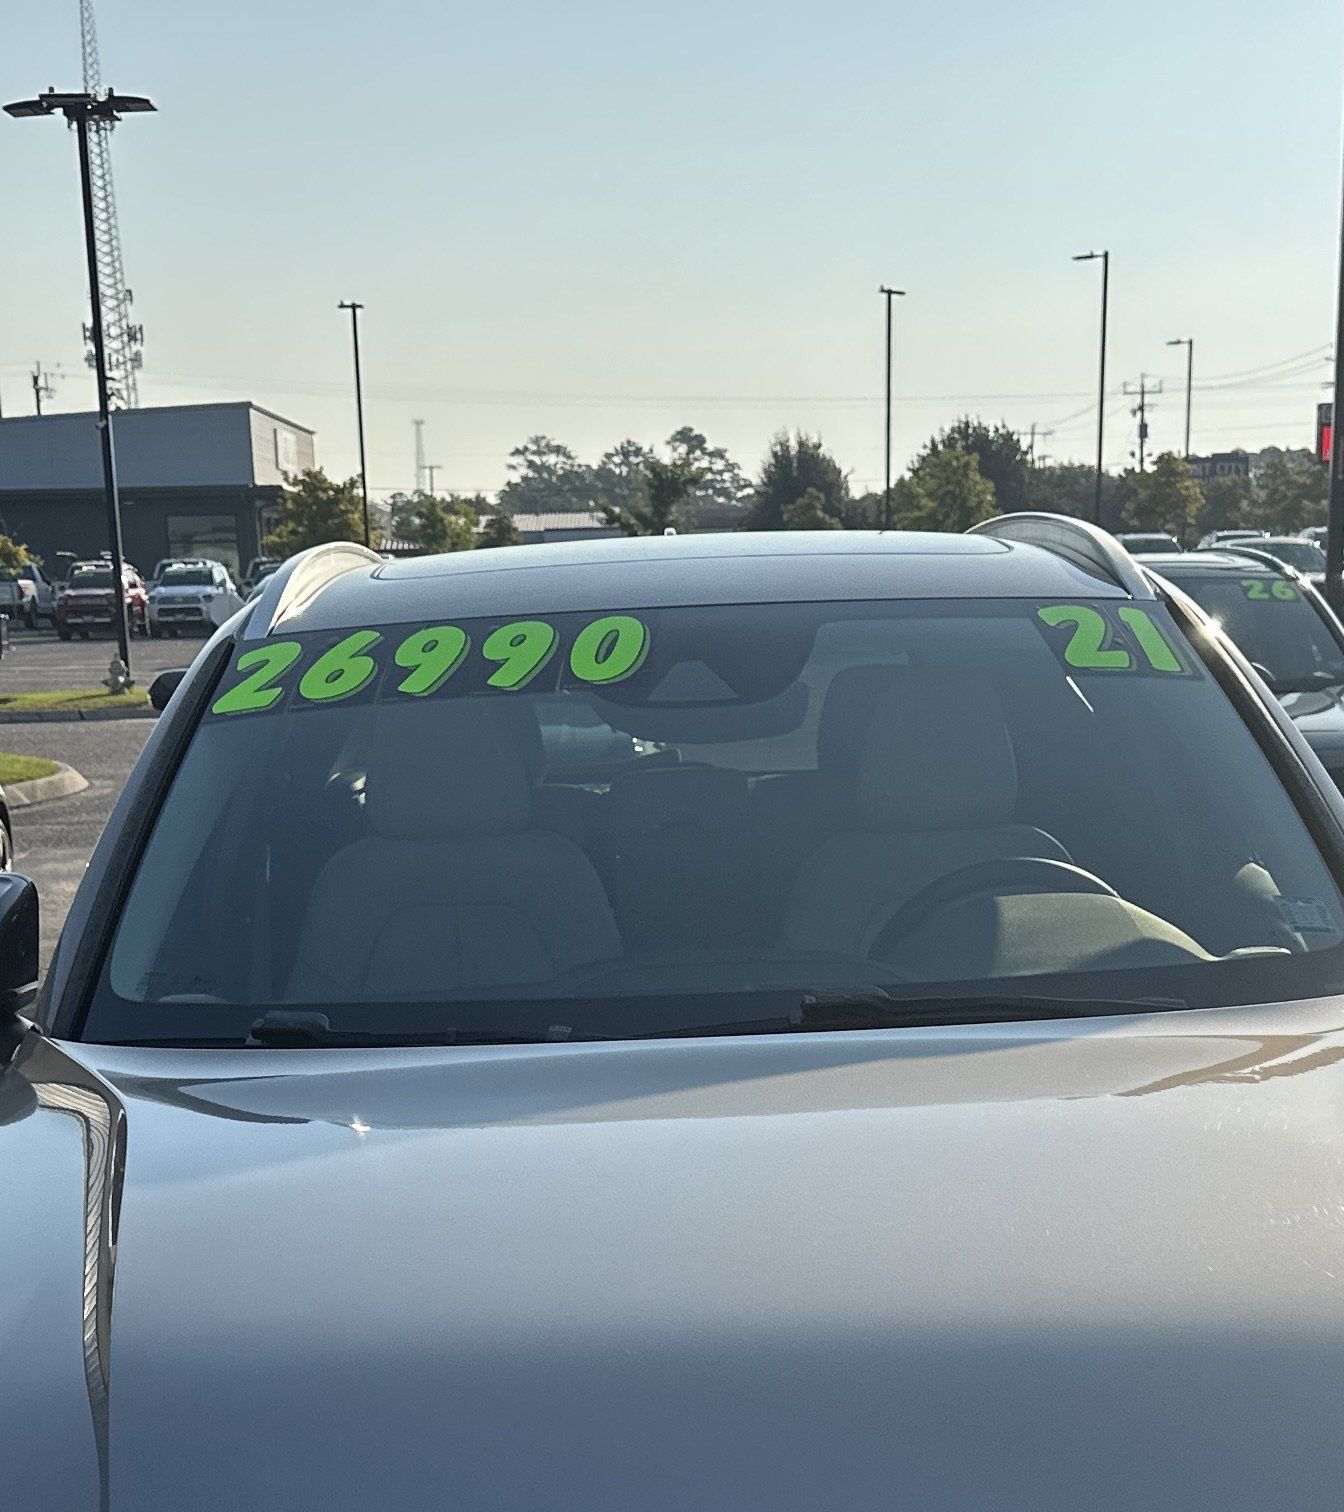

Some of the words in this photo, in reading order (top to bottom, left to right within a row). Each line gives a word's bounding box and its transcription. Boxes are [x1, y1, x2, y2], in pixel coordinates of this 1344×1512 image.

[1241, 579, 1296, 601] 26
[212, 615, 650, 715] 26990
[1037, 604, 1183, 673] 21
